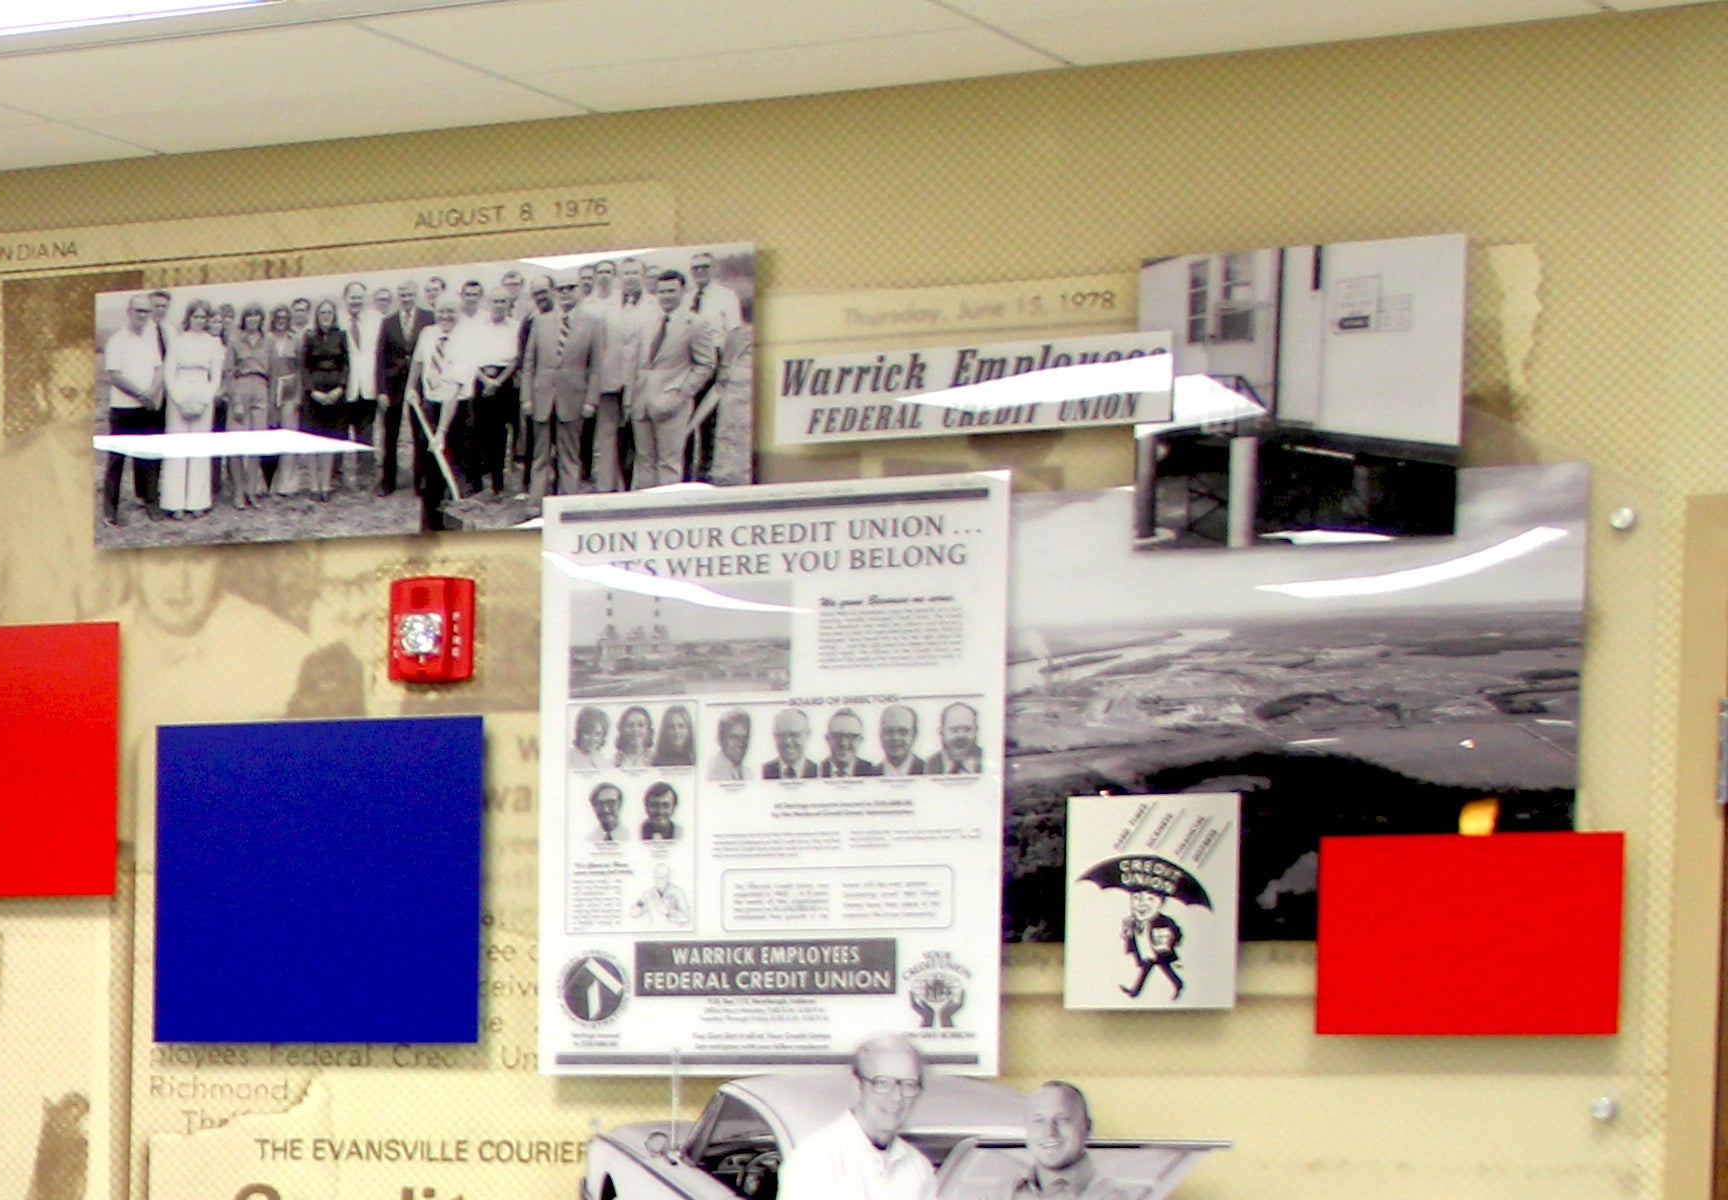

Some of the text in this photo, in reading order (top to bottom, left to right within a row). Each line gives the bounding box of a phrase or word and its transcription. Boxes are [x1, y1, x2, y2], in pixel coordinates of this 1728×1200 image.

[414, 205, 504, 229] AUGUST
[1059, 290, 1116, 310] 1978
[781, 353, 926, 397] Warrick
[806, 392, 1145, 434] FEDERAL UNION
[572, 513, 945, 555] JOIN YOUR CREDIT UNION
[667, 542, 968, 577] WHERE YOU BELONG
[1118, 859, 1183, 881] CREDIT
[1120, 871, 1176, 893] UNION
[671, 945, 861, 966] WARRICK EMPLOYEES
[644, 968, 892, 991] FEDERAL CREDIT UNION
[254, 1137, 469, 1162] THE EVANSVILLE
